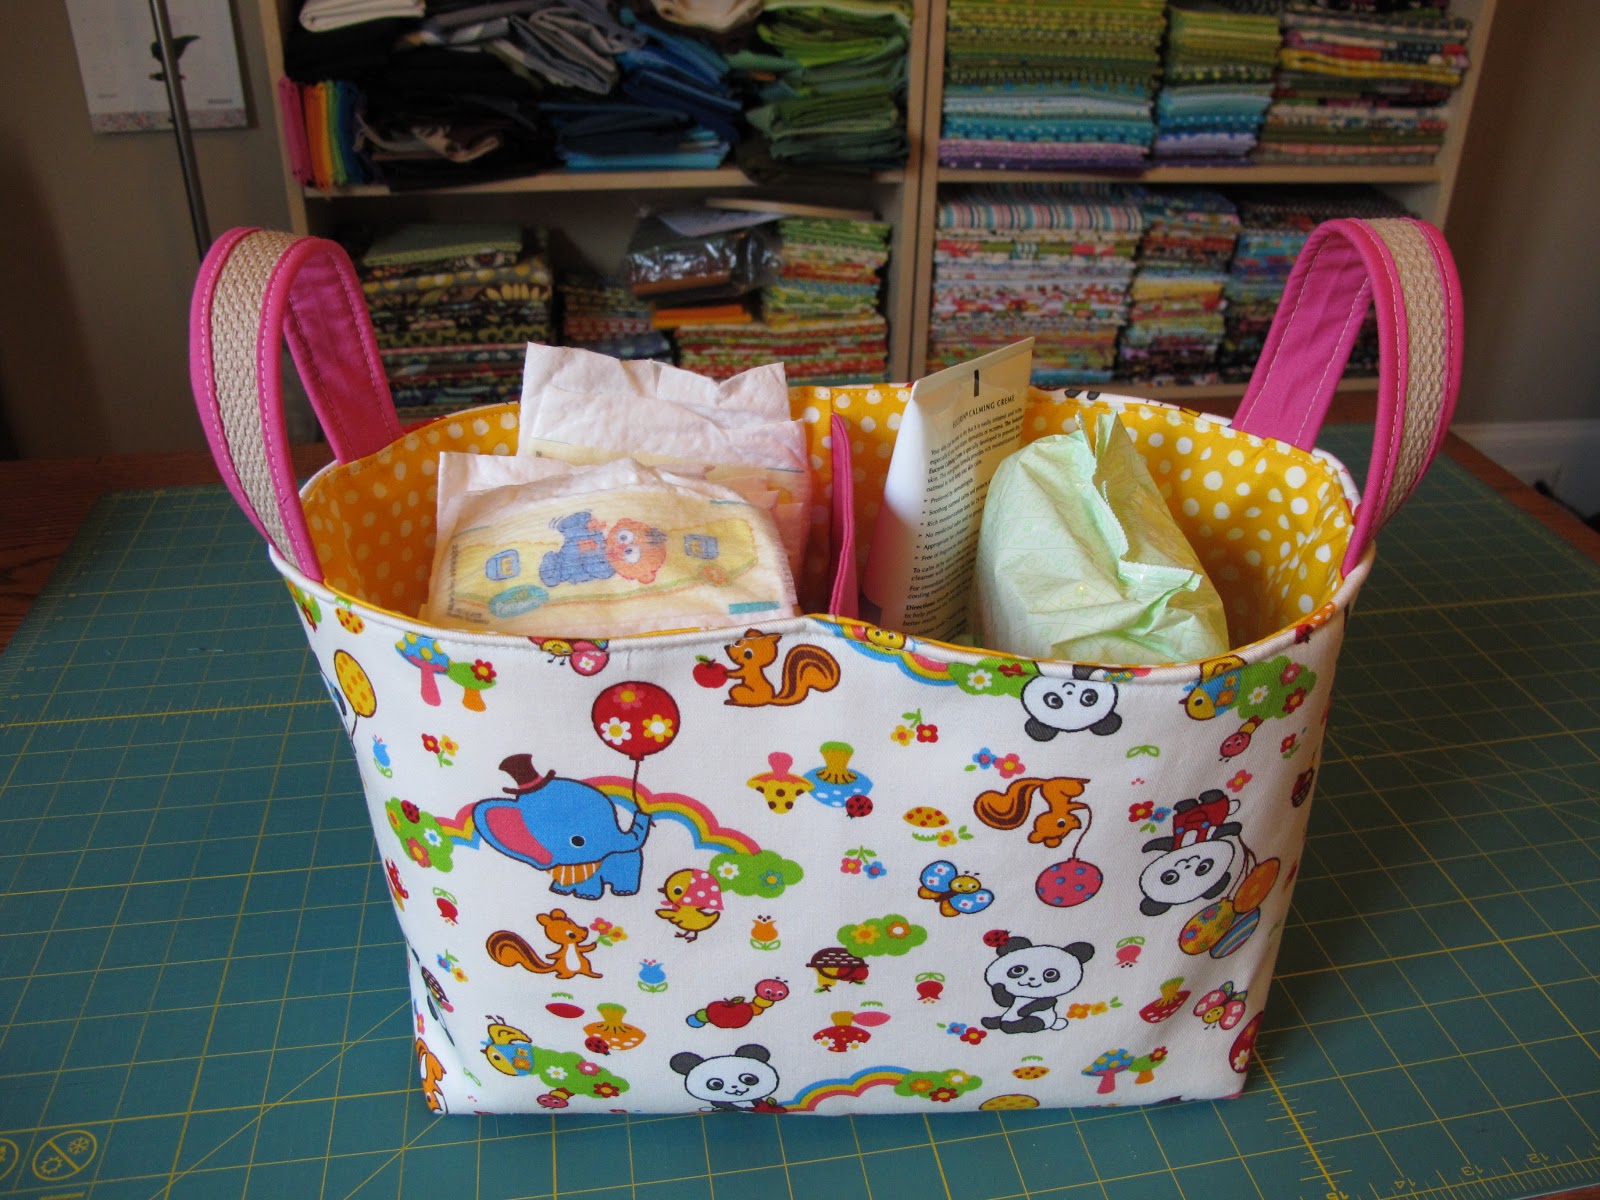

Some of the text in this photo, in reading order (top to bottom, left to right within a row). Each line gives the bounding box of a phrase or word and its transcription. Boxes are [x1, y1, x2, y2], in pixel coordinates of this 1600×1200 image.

[968, 402, 995, 417] CALMING
[997, 394, 1015, 407] CREME
[1526, 1151, 1549, 1164] 12
[1460, 1164, 1483, 1177] 13
[1394, 1177, 1416, 1189] 14
